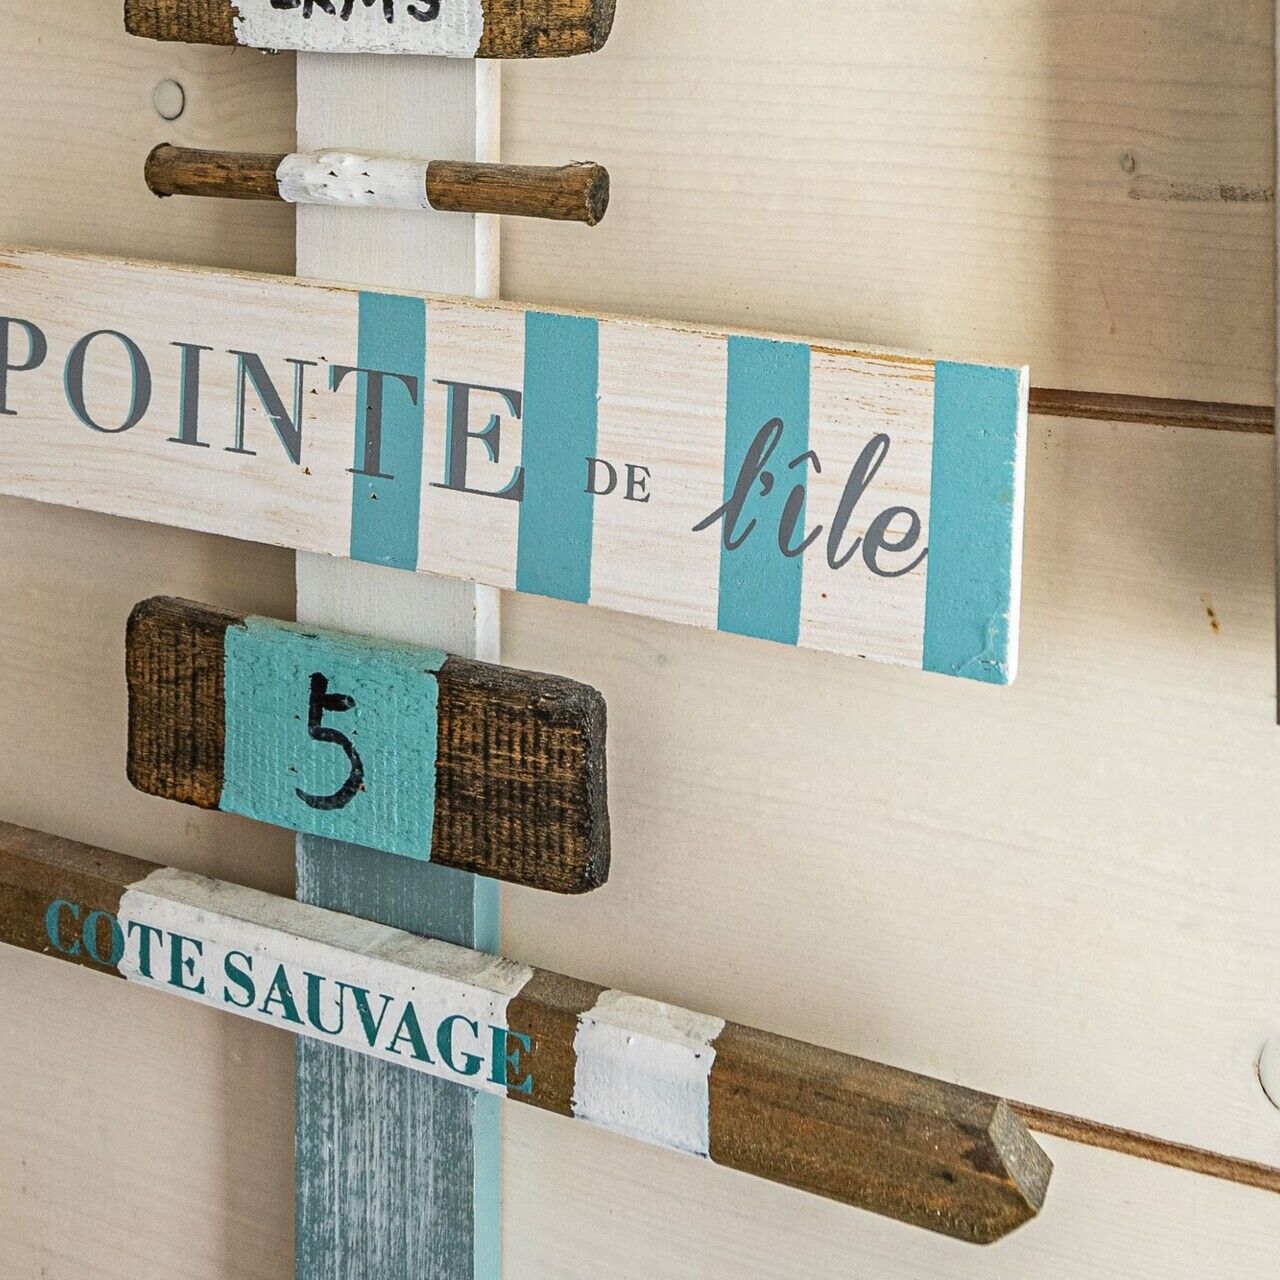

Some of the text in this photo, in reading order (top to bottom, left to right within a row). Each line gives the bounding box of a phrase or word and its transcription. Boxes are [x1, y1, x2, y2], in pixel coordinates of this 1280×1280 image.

[584, 457, 653, 505] DE
[292, 671, 366, 811] 5
[45, 899, 535, 1096] COTE SAUVAGE
